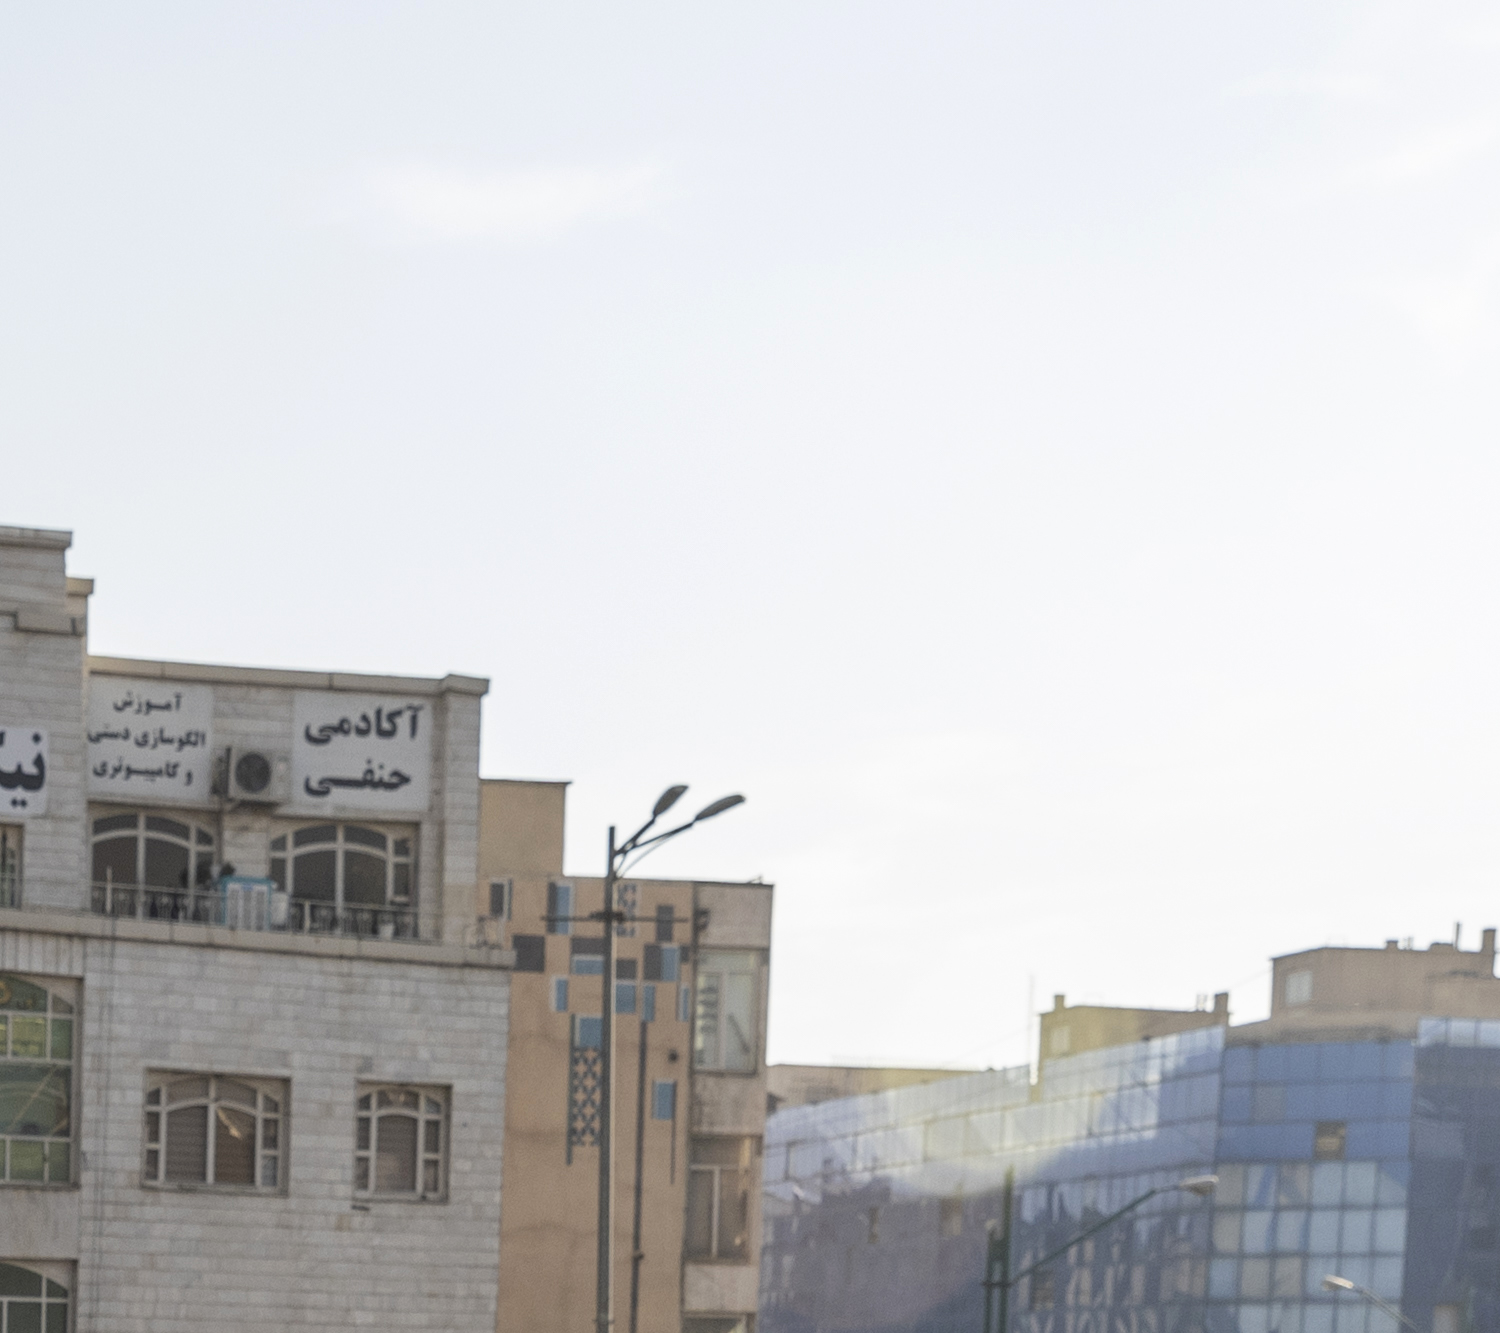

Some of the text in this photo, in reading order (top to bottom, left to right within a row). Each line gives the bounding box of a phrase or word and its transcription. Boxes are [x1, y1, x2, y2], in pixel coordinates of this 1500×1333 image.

[113, 691, 182, 715] آموزش
[304, 704, 424, 745] آکادمی
[303, 758, 411, 797] حنفی
